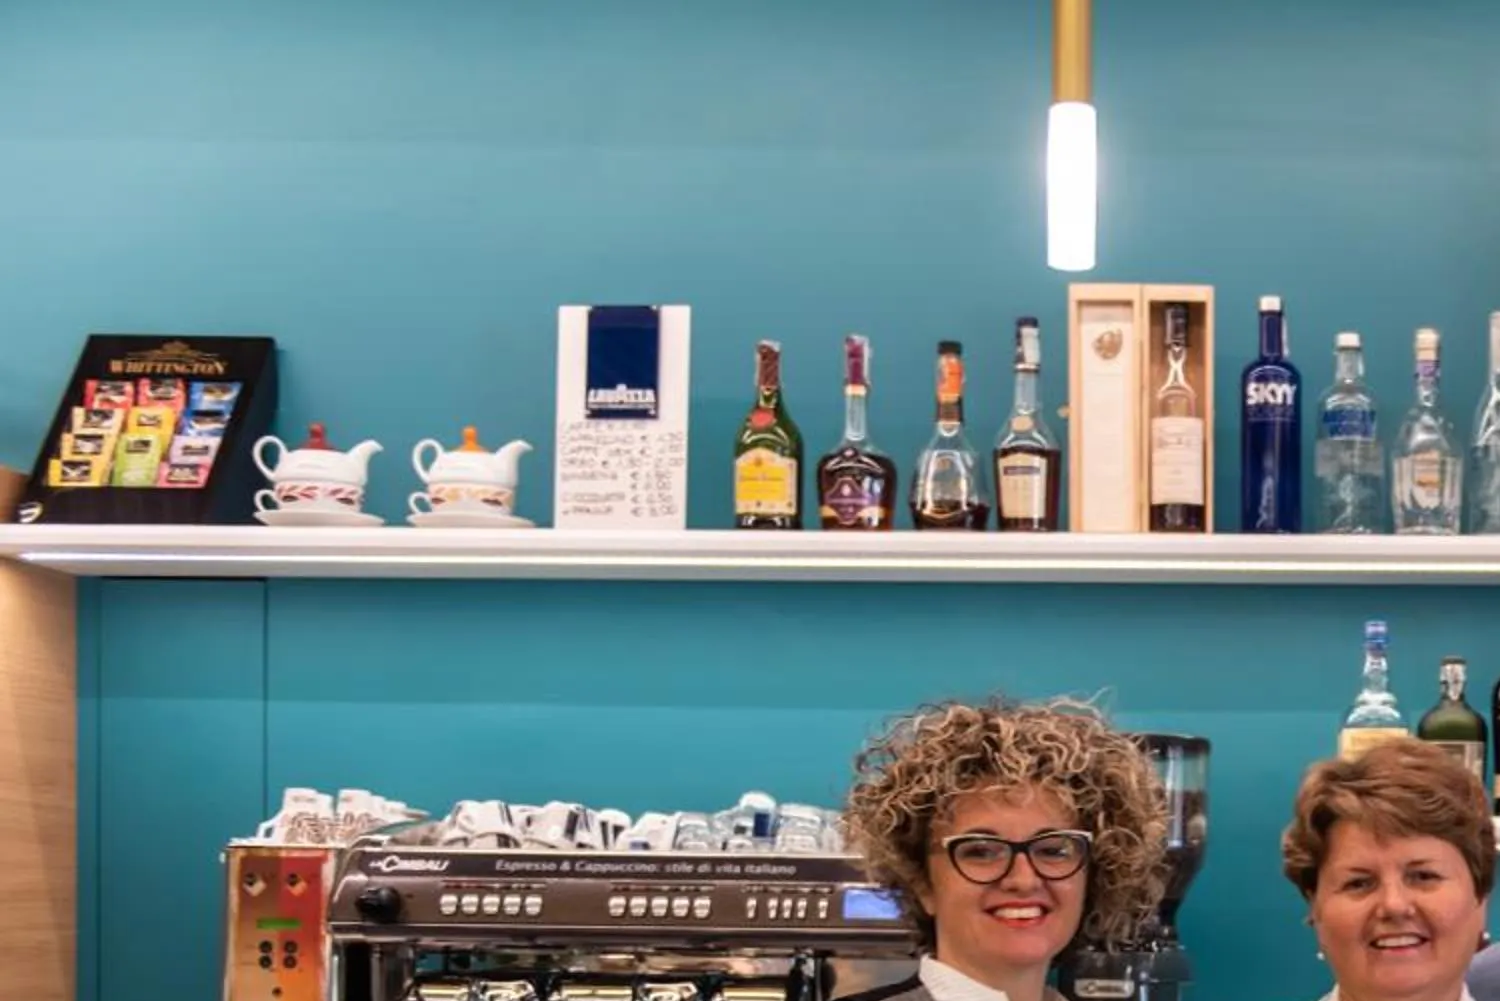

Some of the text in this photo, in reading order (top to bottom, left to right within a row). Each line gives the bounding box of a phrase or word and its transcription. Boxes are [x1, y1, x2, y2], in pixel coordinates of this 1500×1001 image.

[1247, 382, 1297, 405] SKYY
[495, 859, 557, 872] Espresso
[560, 860, 571, 871] &
[664, 861, 694, 873] stile
[697, 861, 712, 873] di
[715, 862, 741, 874] vita
